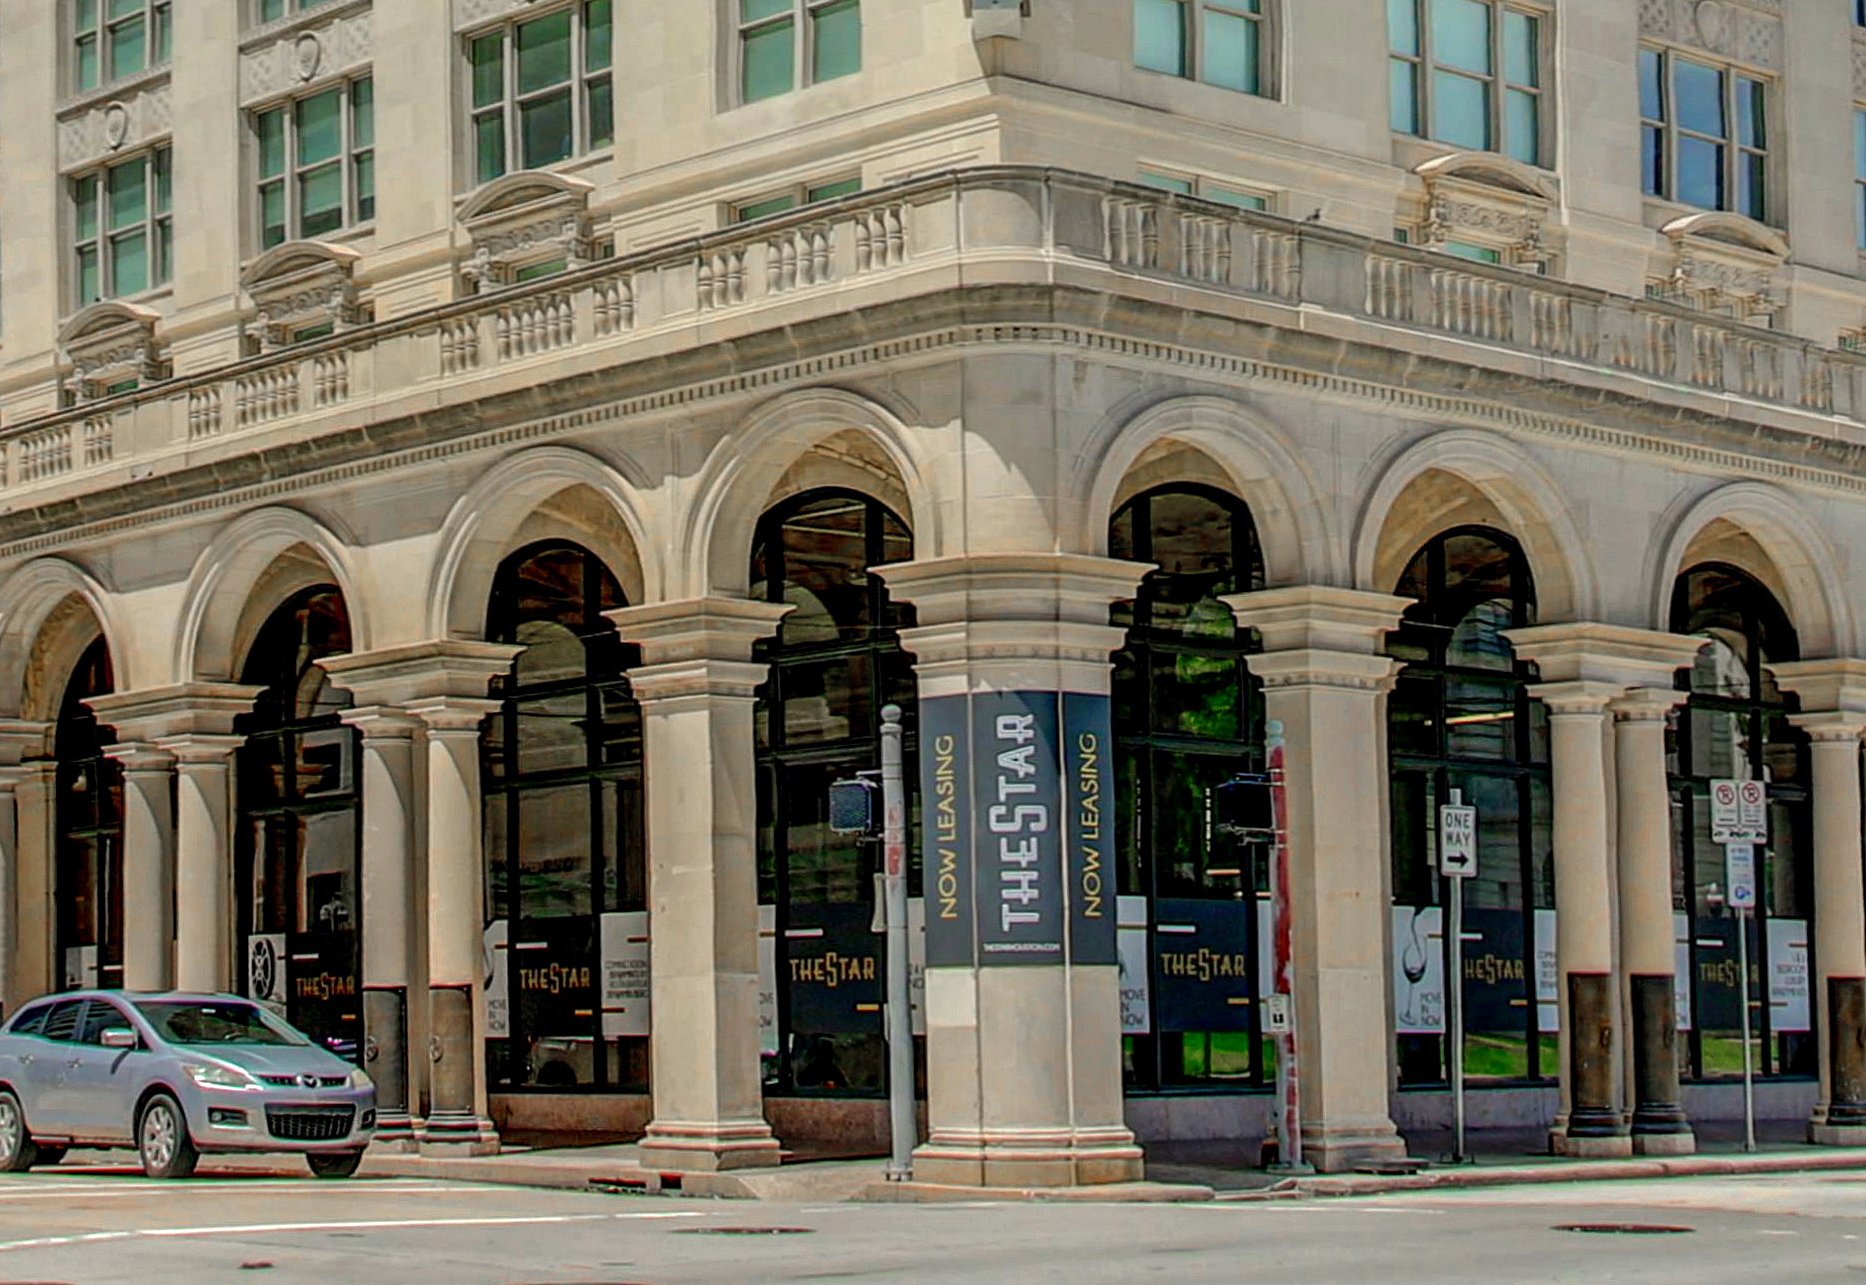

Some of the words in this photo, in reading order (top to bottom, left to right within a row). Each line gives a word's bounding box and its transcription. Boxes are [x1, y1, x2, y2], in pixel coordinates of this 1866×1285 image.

[935, 735, 956, 842] LEASING
[1079, 733, 1099, 841] LEASING
[1445, 813, 1471, 828] ONE
[1445, 832, 1471, 847] WAY
[939, 849, 957, 919] NOW
[1082, 846, 1101, 918] NOW
[1465, 953, 1526, 985] HESTAR
